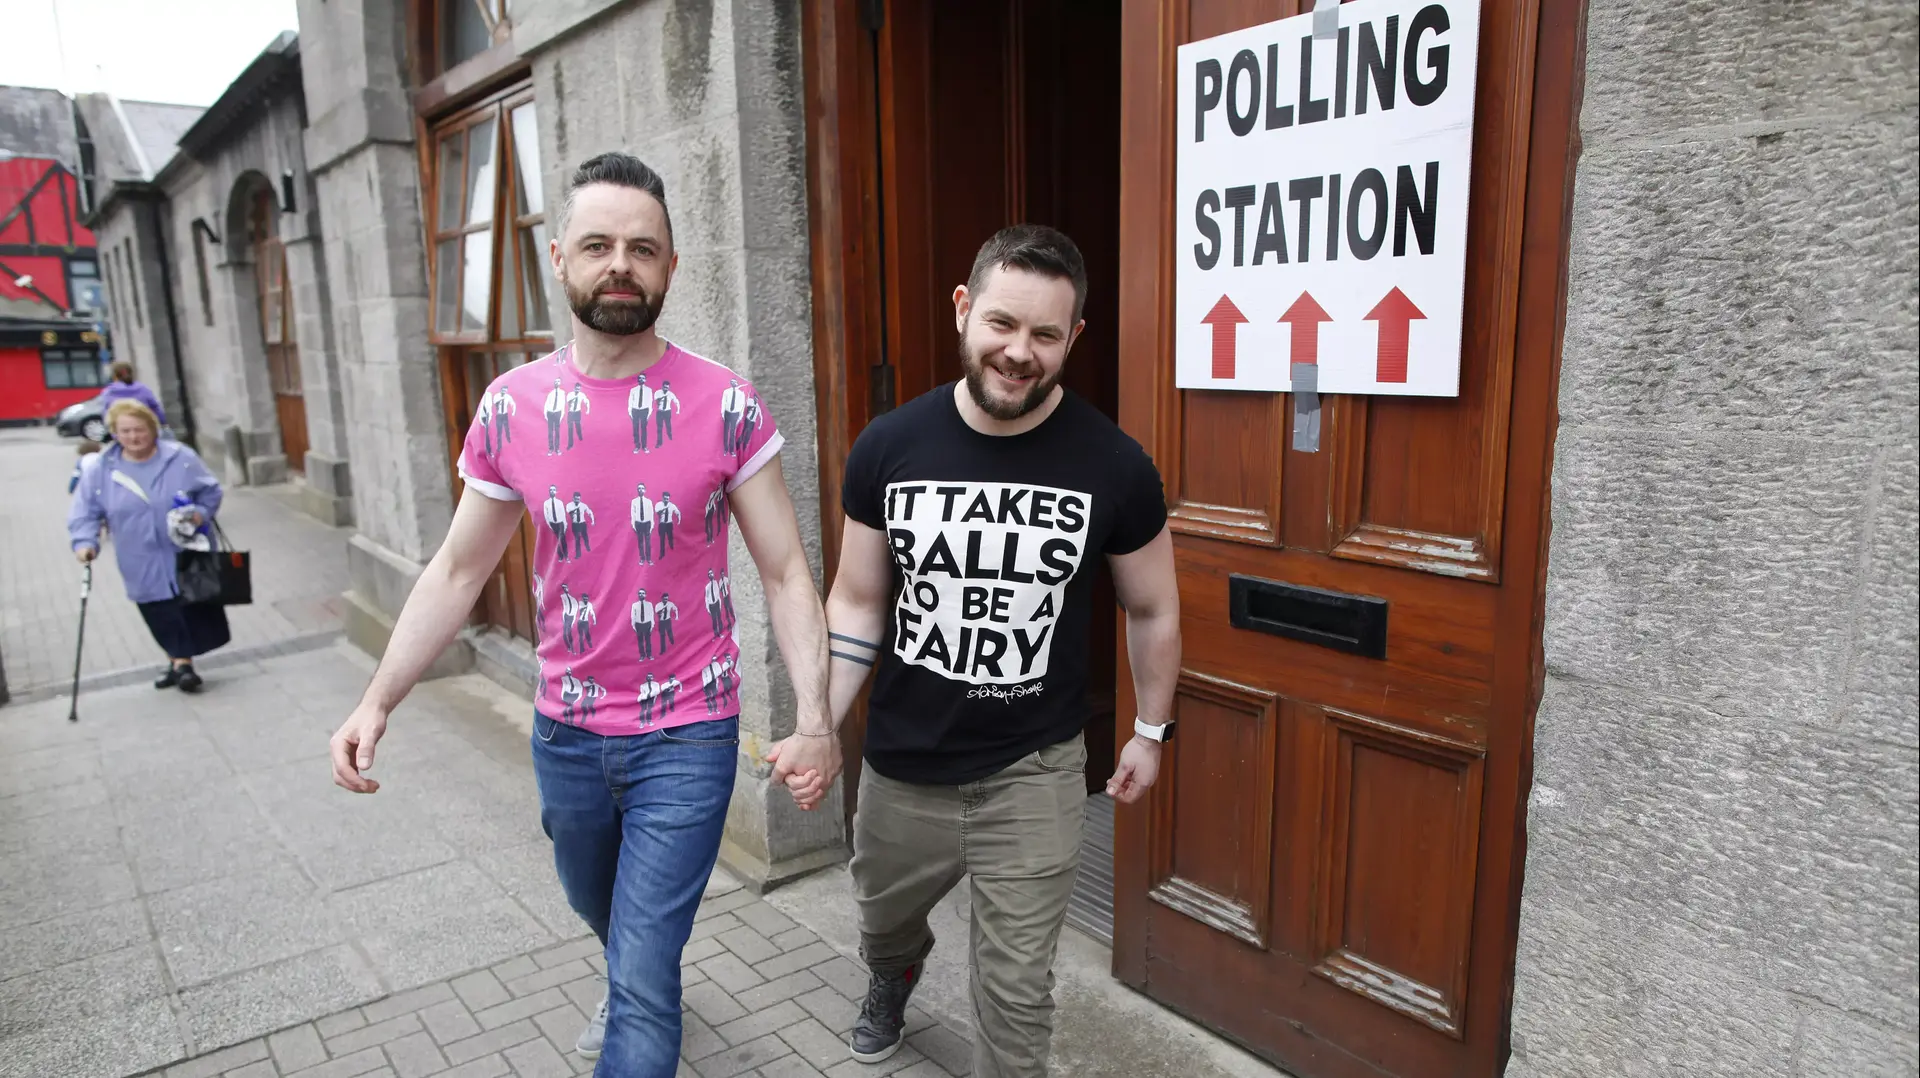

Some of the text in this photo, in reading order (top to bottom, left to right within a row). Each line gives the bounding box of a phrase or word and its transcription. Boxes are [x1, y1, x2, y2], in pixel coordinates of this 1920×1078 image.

[1195, 4, 1451, 143] POLLING
[1193, 161, 1440, 271] STATION
[887, 486, 1085, 533] IT TAKES
[889, 528, 1078, 586] BALLS
[962, 586, 1015, 623] BE
[1028, 591, 1054, 621] A
[897, 607, 1052, 678] FAIRY
